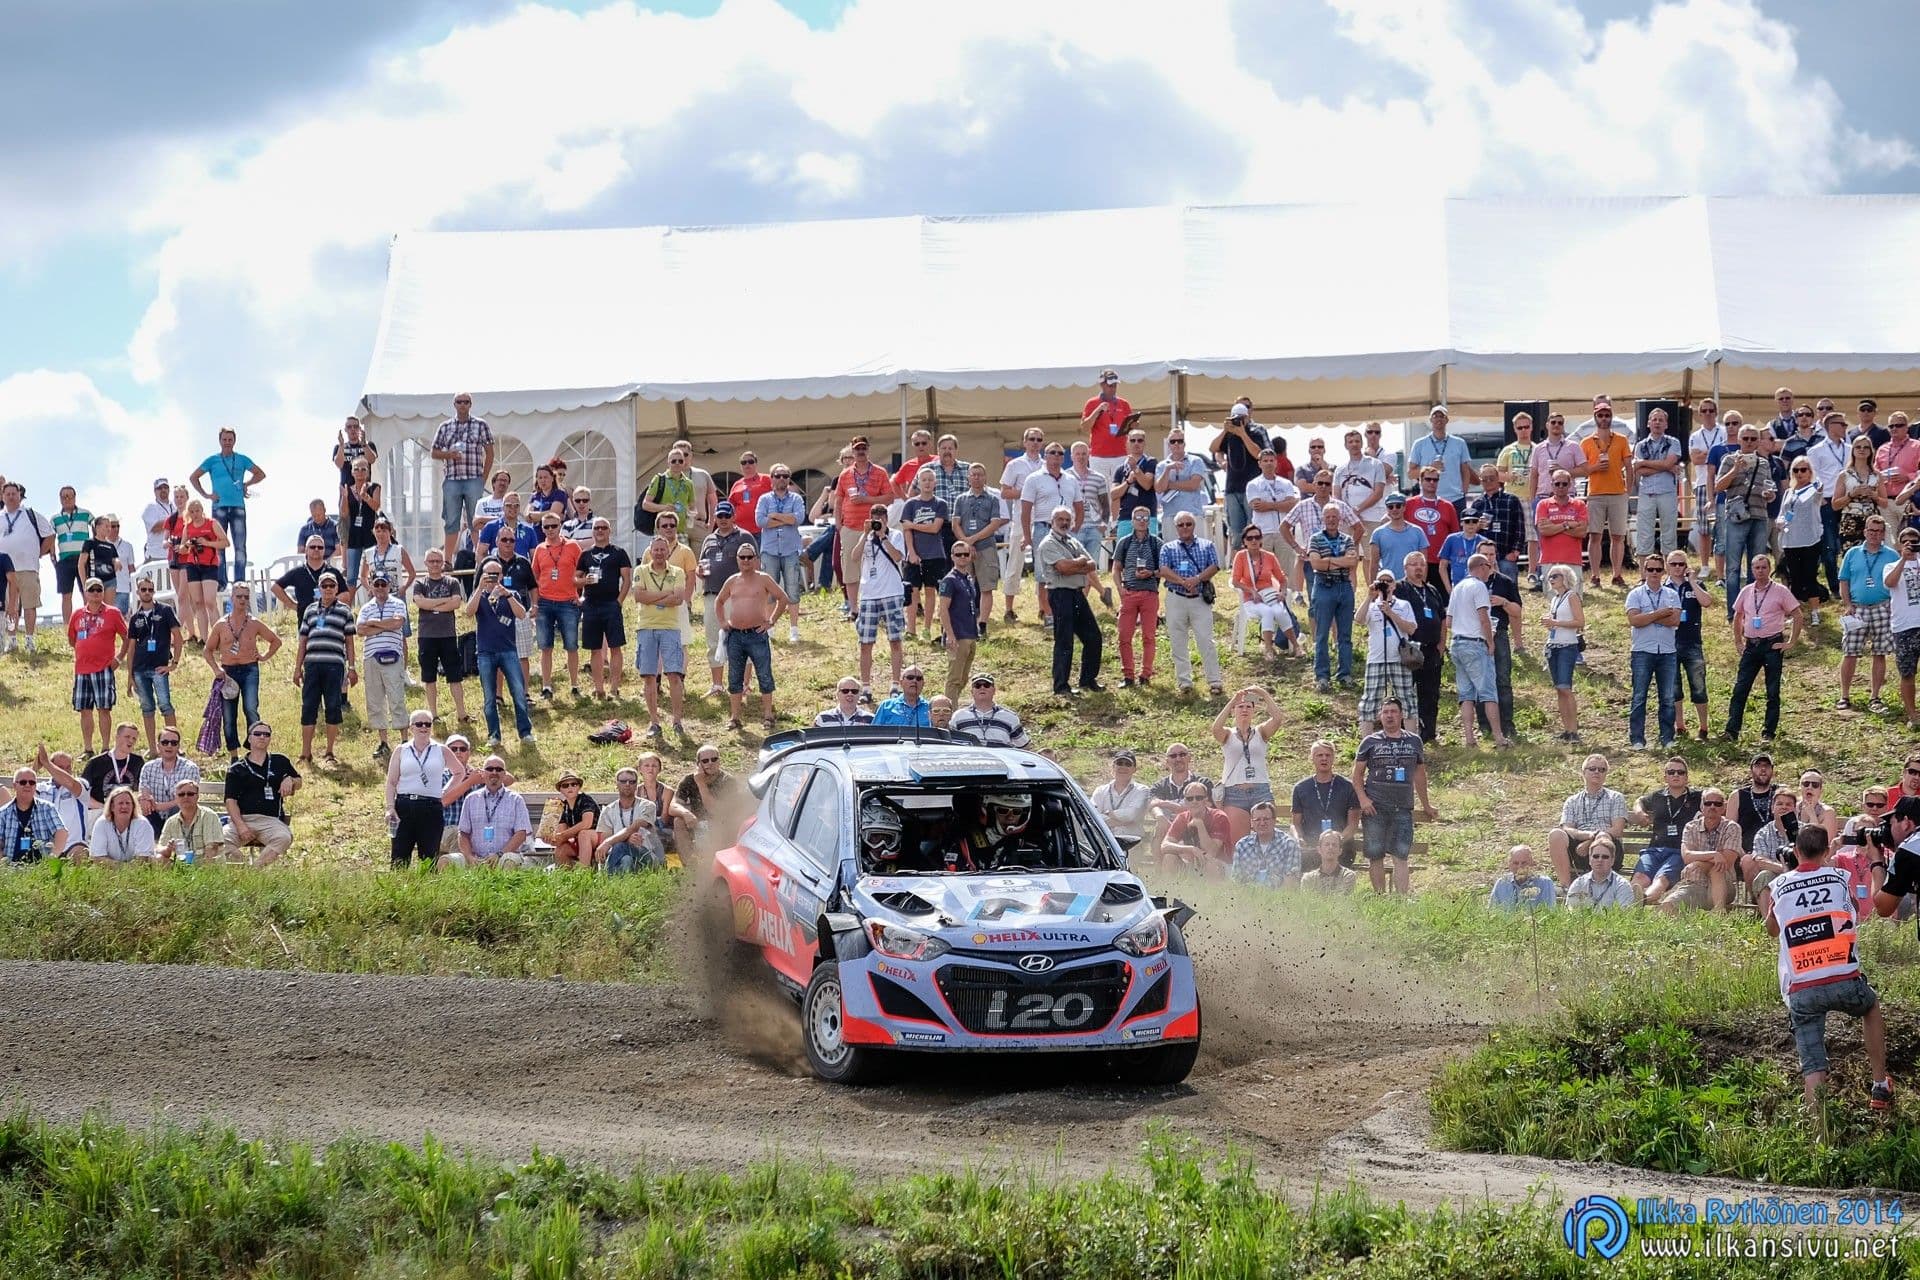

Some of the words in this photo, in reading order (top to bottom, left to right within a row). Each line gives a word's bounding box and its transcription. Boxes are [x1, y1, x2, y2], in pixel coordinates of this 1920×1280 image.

[1807, 876, 1826, 886] RALLY
[1795, 887, 1833, 908] 422
[758, 907, 796, 957] HELIX
[988, 929, 1041, 943] HELIX
[1041, 932, 1091, 943] ULTRA
[1788, 922, 1827, 939] Lexar
[1807, 947, 1829, 956] AUGUST
[1152, 960, 1168, 975] HELIX
[1796, 955, 1823, 970] 2014
[885, 965, 917, 983] HELIX
[985, 990, 1094, 1030] i20
[905, 1033, 943, 1041] MICHELIN
[1135, 1028, 1160, 1036] MICHELIN
